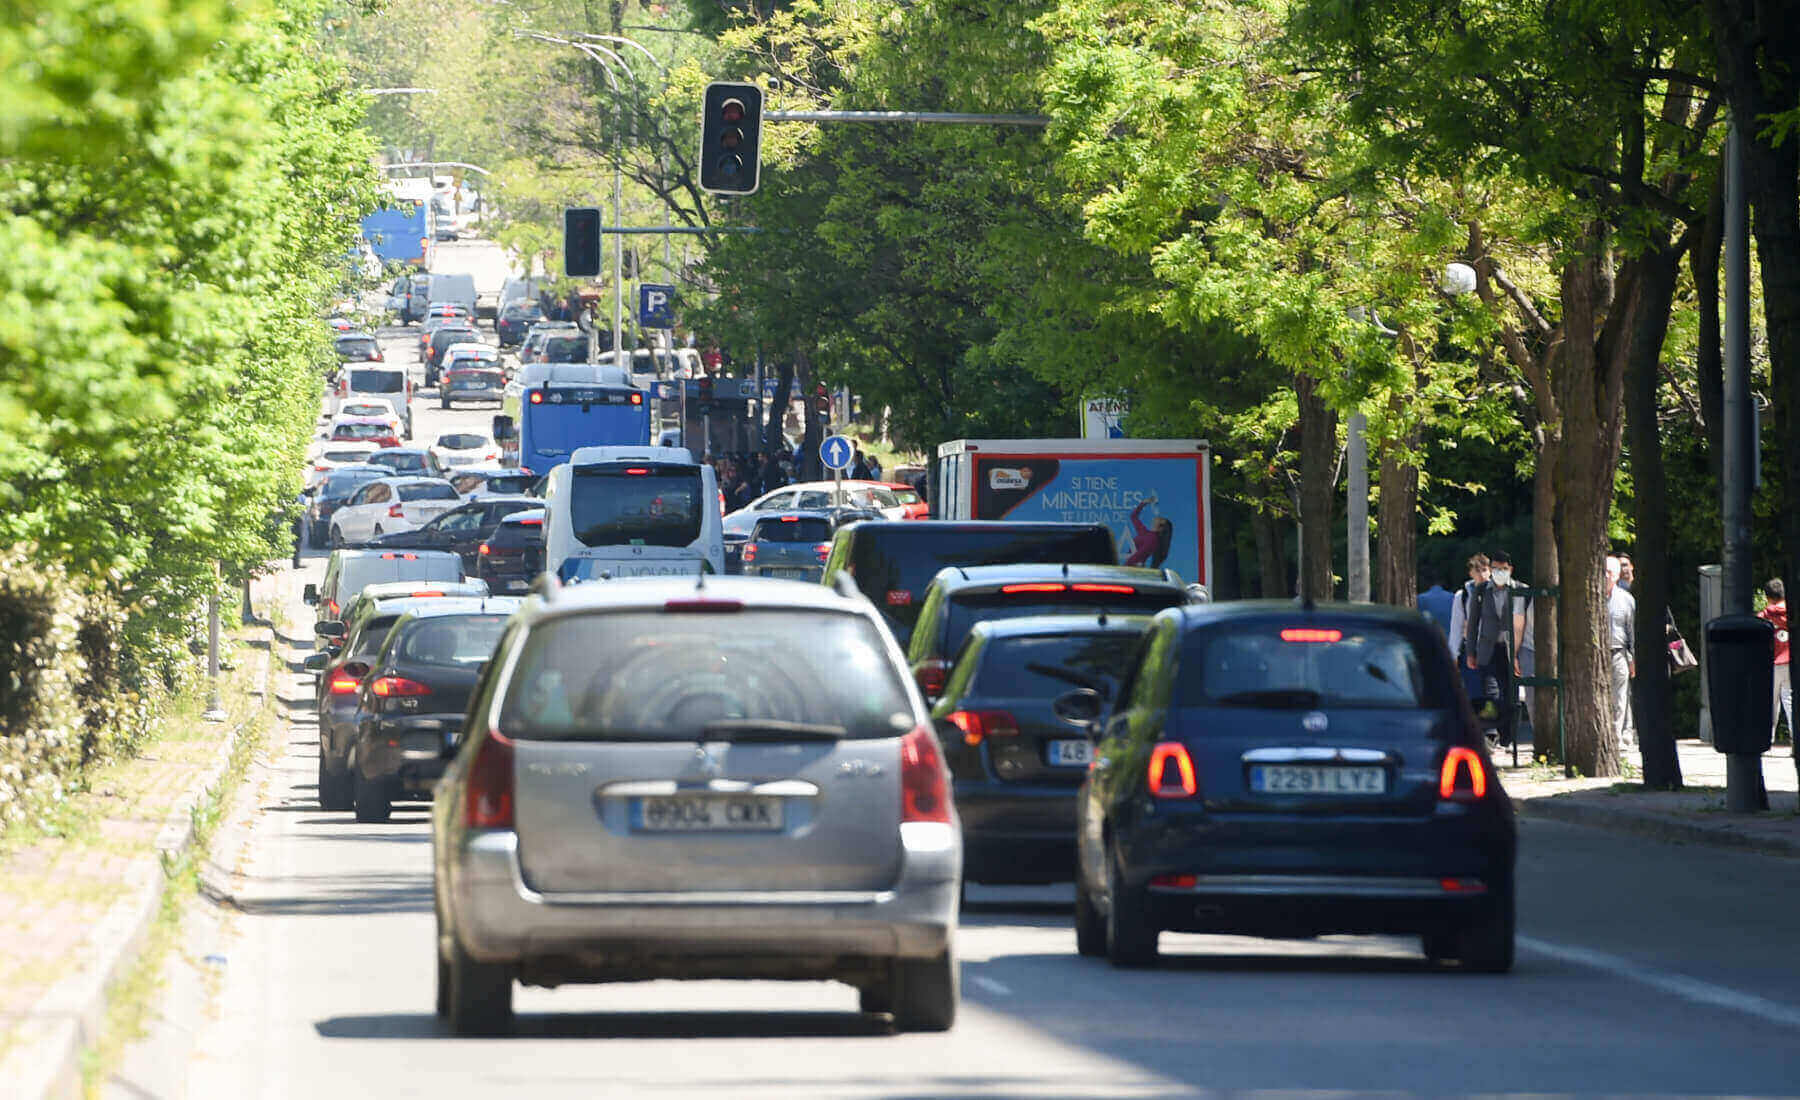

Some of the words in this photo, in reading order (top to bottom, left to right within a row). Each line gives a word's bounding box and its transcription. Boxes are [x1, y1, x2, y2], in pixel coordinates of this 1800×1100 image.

[648, 290, 667, 313] P
[1071, 476, 1082, 490] SI
[1084, 476, 1119, 490] TIENE
[1041, 490, 1144, 511] MINERALES
